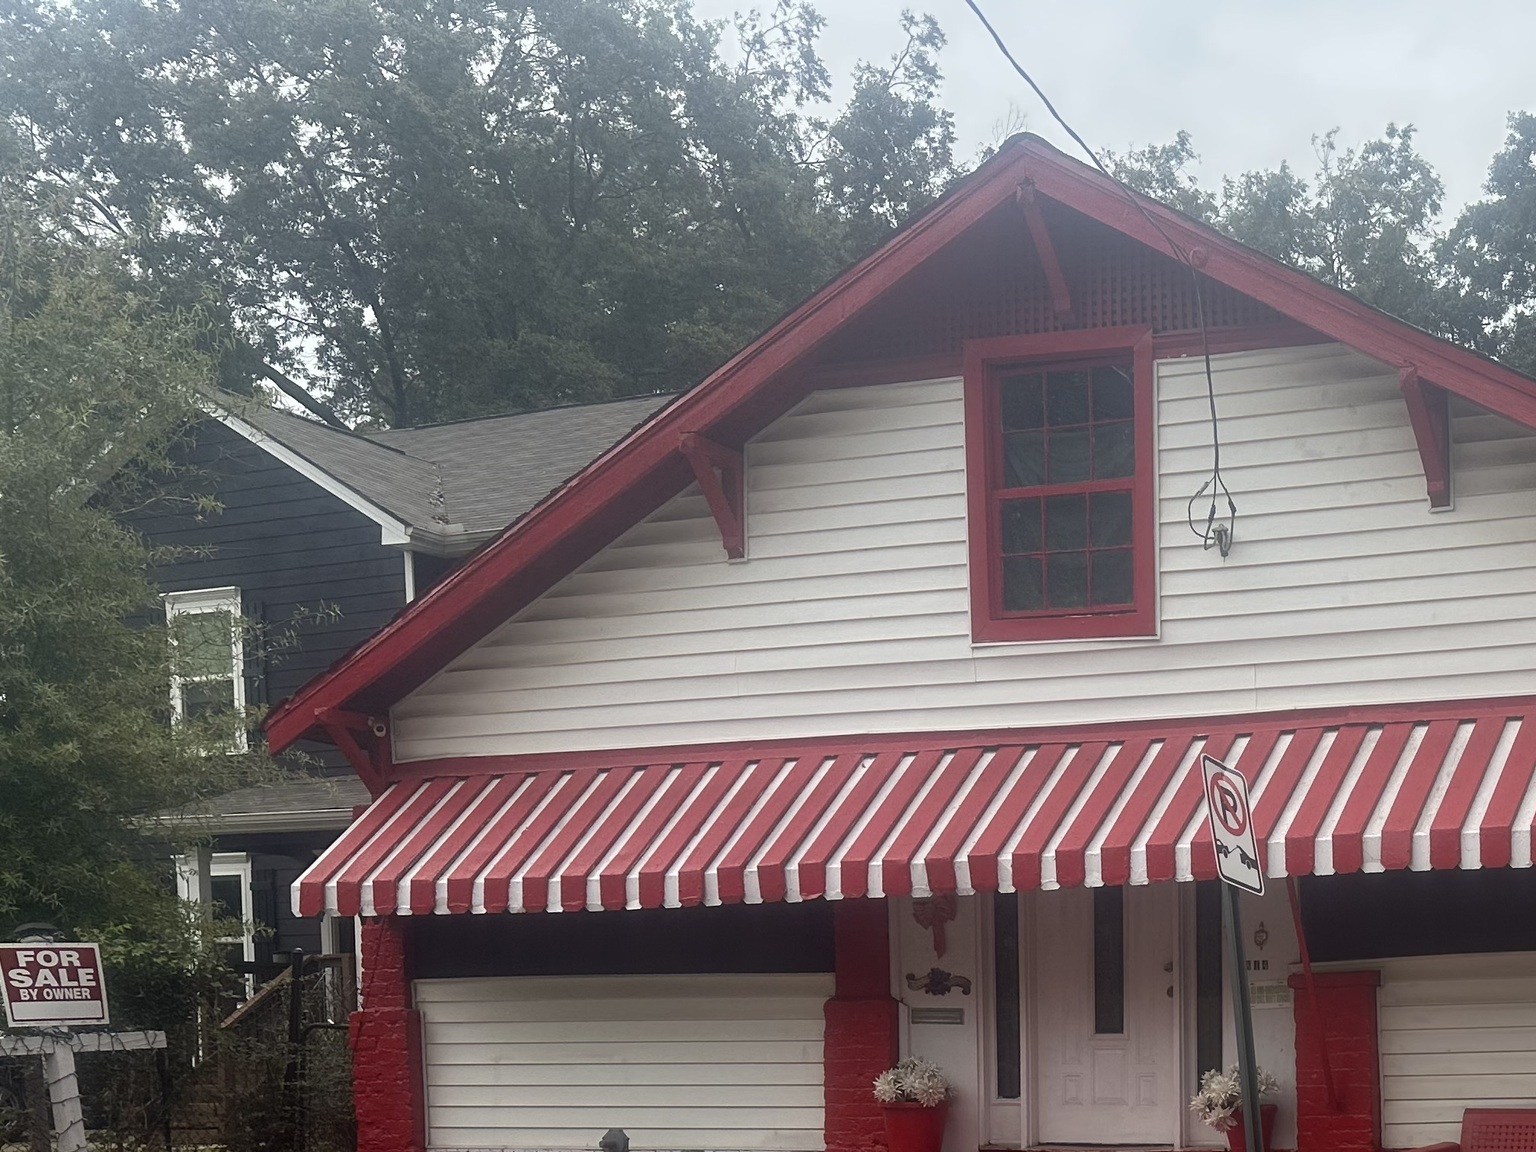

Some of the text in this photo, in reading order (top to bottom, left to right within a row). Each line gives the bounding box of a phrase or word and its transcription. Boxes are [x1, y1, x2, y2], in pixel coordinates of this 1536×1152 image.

[16, 951, 81, 967] FOR
[8, 968, 96, 988] SALE
[19, 988, 91, 1001] BY OWNER
